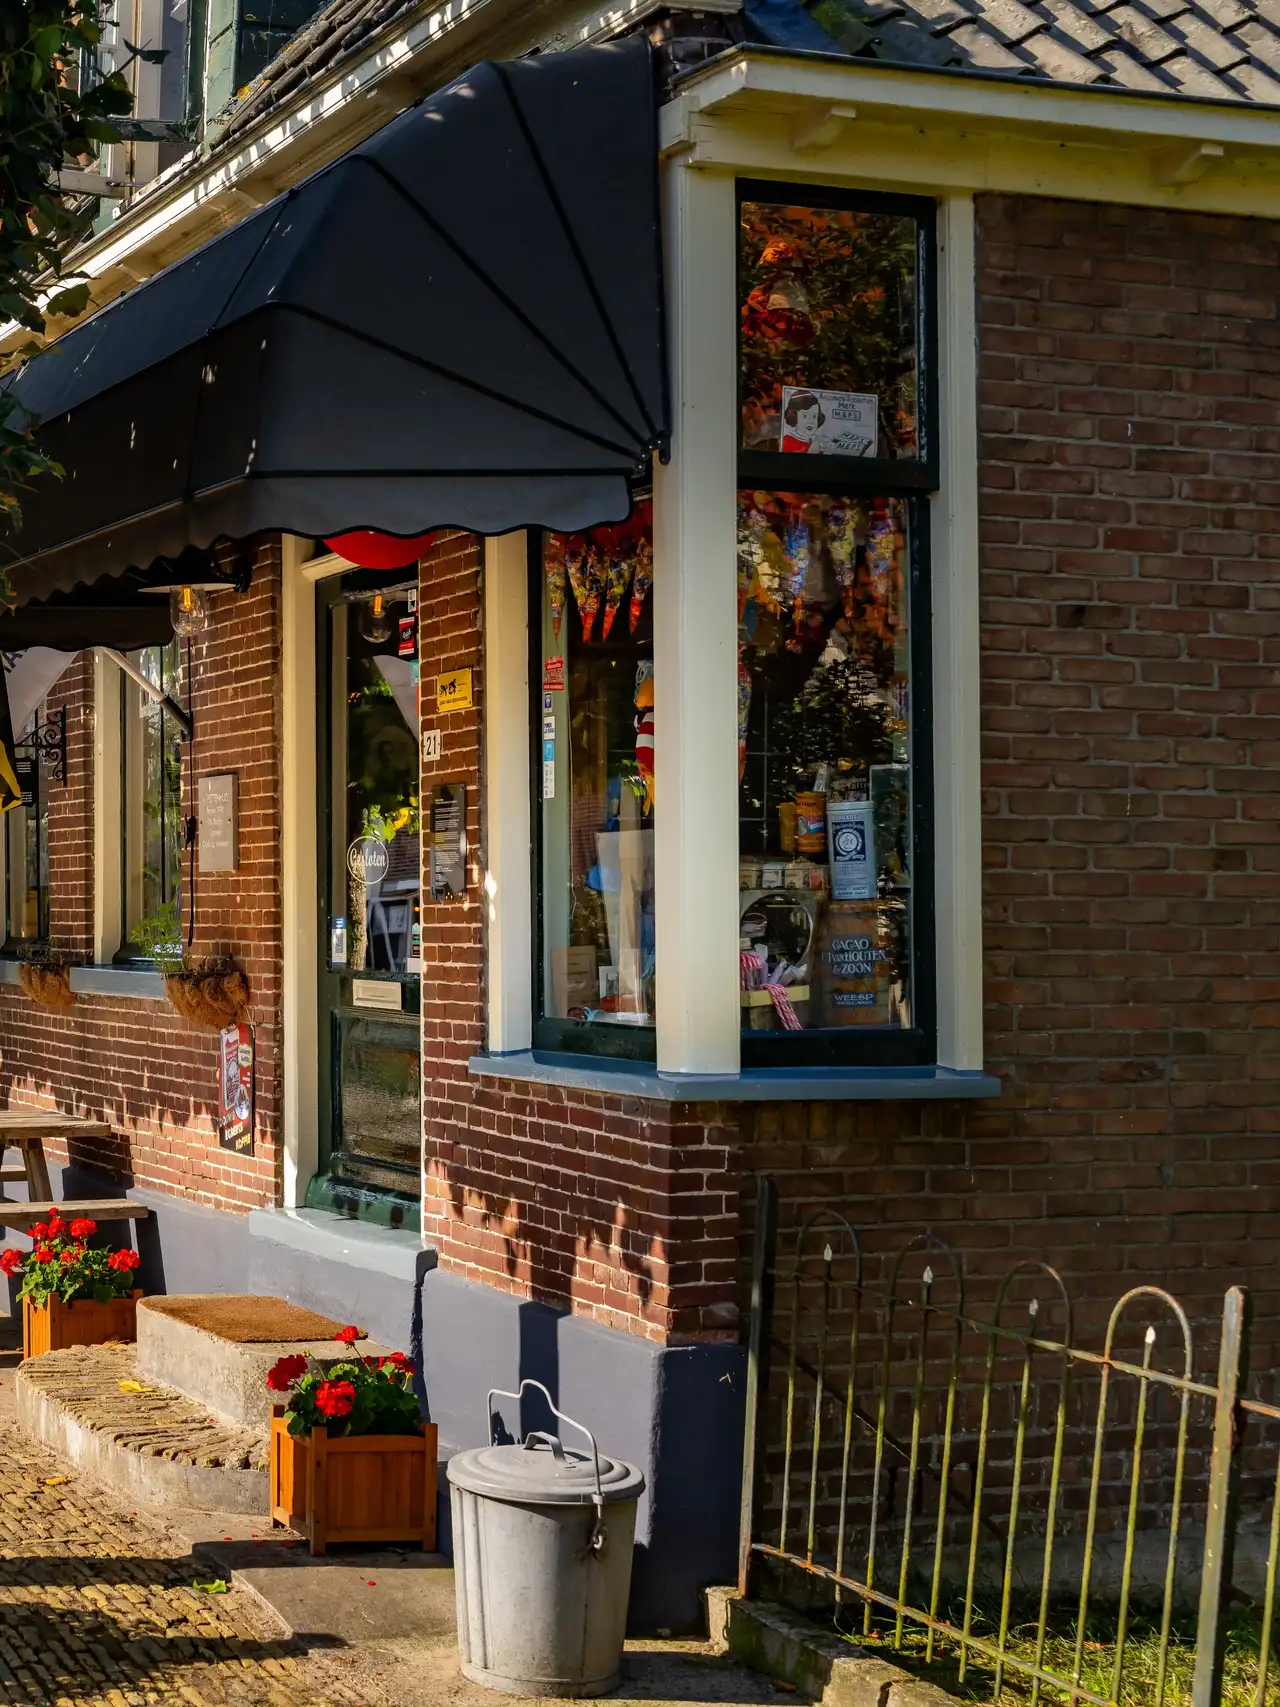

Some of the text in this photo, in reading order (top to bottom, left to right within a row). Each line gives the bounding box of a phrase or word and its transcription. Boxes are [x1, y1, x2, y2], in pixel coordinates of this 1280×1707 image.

[426, 735, 436, 756] 21
[832, 938, 869, 951] CACAO
[841, 962, 872, 974] ZOON
[833, 993, 874, 1002] WEESP
